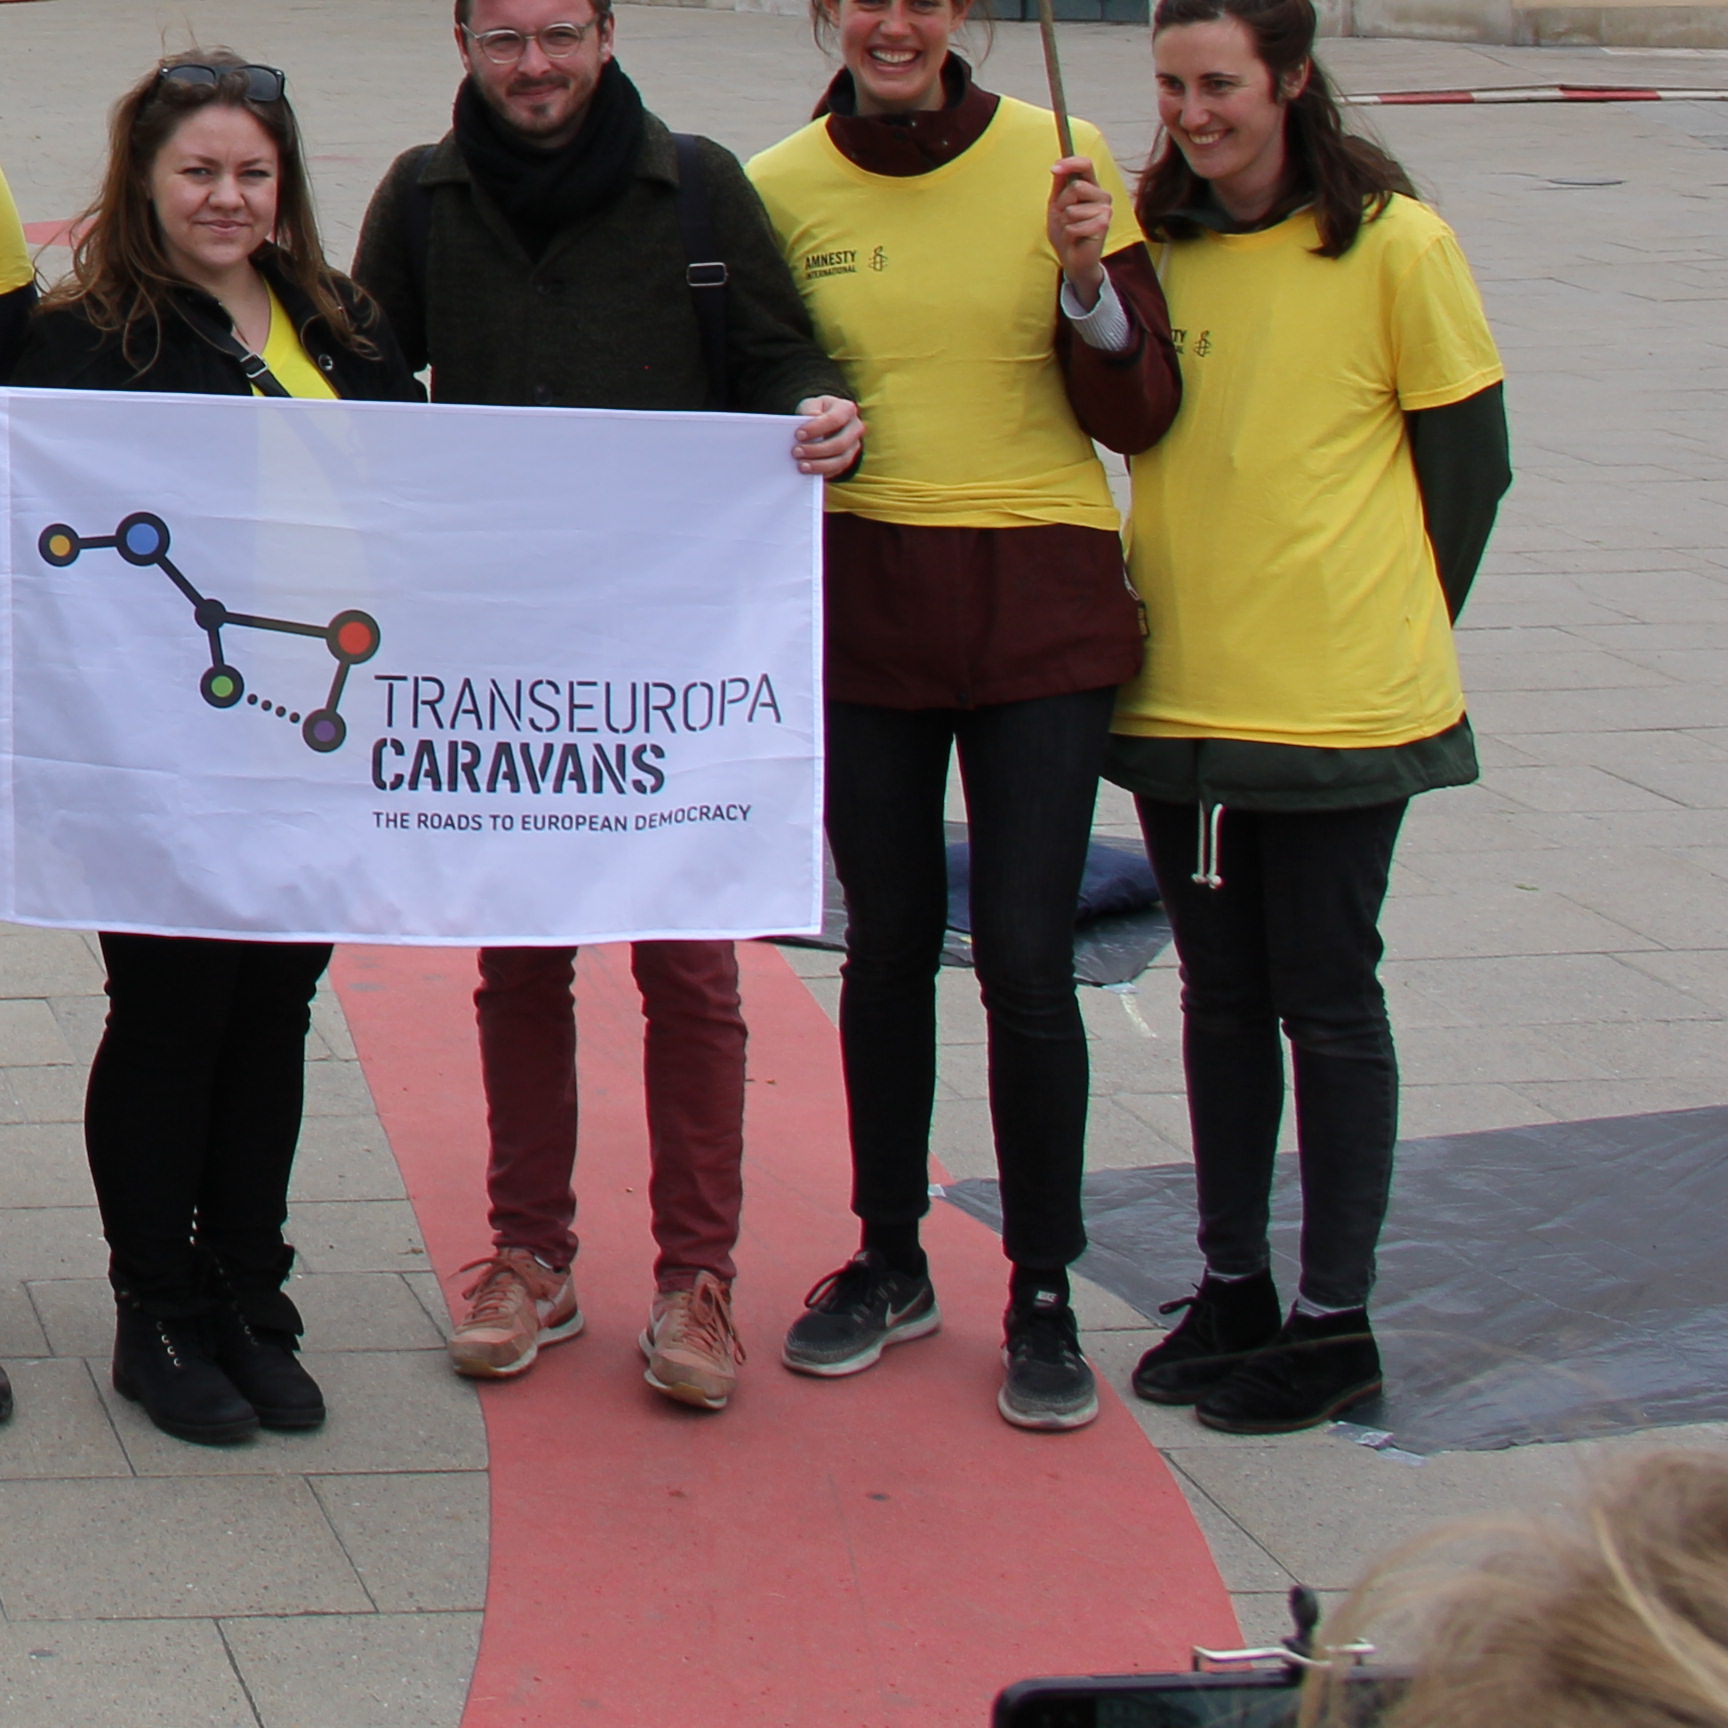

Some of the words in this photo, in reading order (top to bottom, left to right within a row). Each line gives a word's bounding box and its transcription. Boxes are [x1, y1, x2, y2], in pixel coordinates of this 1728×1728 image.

[804, 250, 858, 271] AMNESTY
[373, 672, 782, 735] TRANSEUROPA
[370, 736, 667, 796] CARAVANS
[372, 811, 410, 830] THE
[417, 811, 483, 831] ROADS
[489, 814, 515, 832] TO
[520, 814, 629, 833] EUROPEAN
[634, 803, 752, 832] DEMOCRACY
